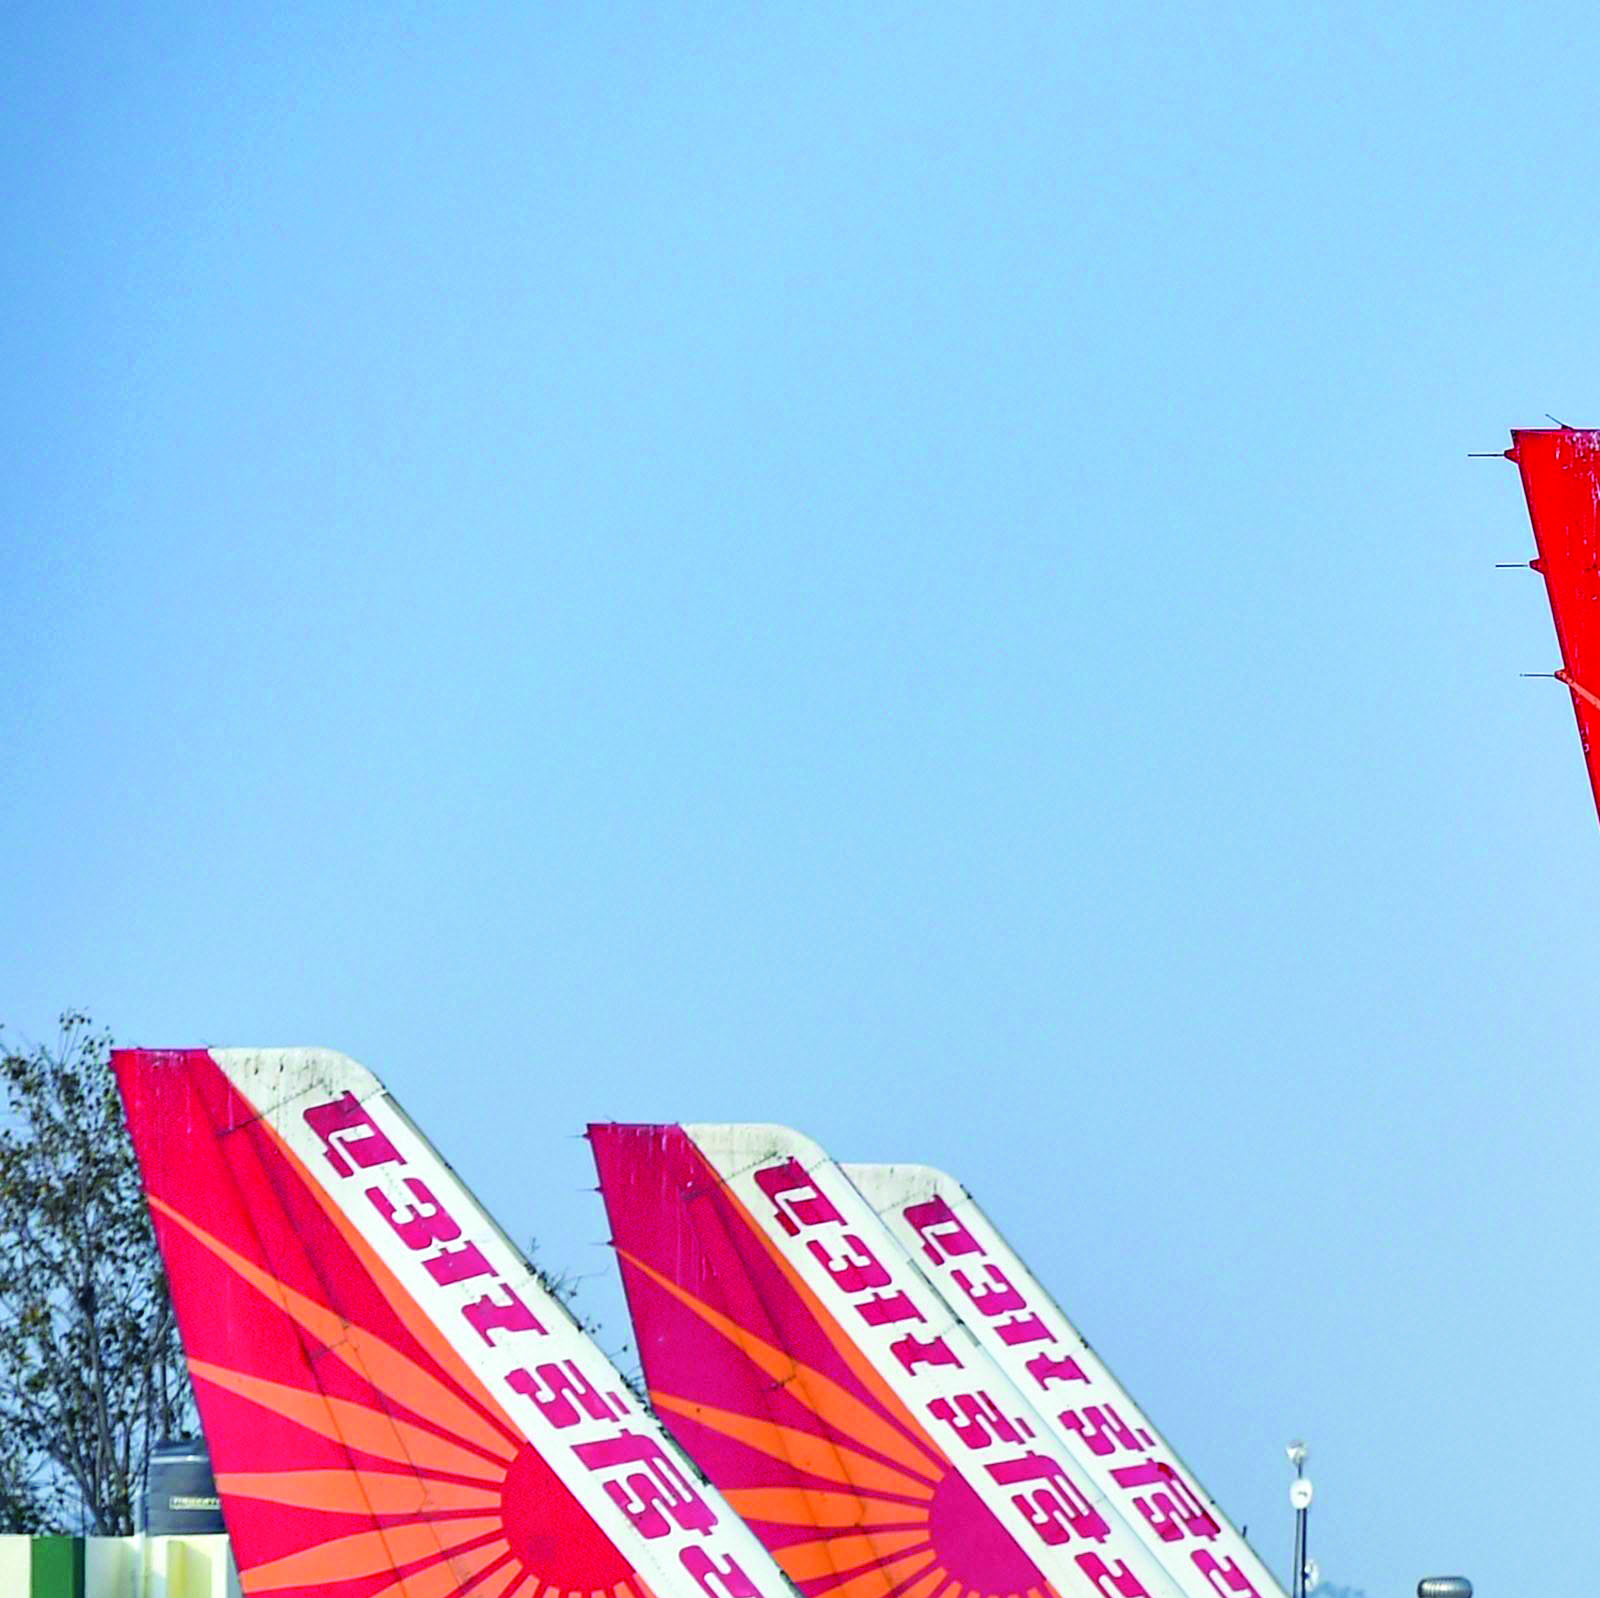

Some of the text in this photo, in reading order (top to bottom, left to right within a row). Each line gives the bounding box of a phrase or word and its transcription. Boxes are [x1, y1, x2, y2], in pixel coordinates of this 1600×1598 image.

[302, 1090, 549, 1348] एअर
[754, 1156, 965, 1377] एअर
[903, 1195, 1091, 1391] एअर
